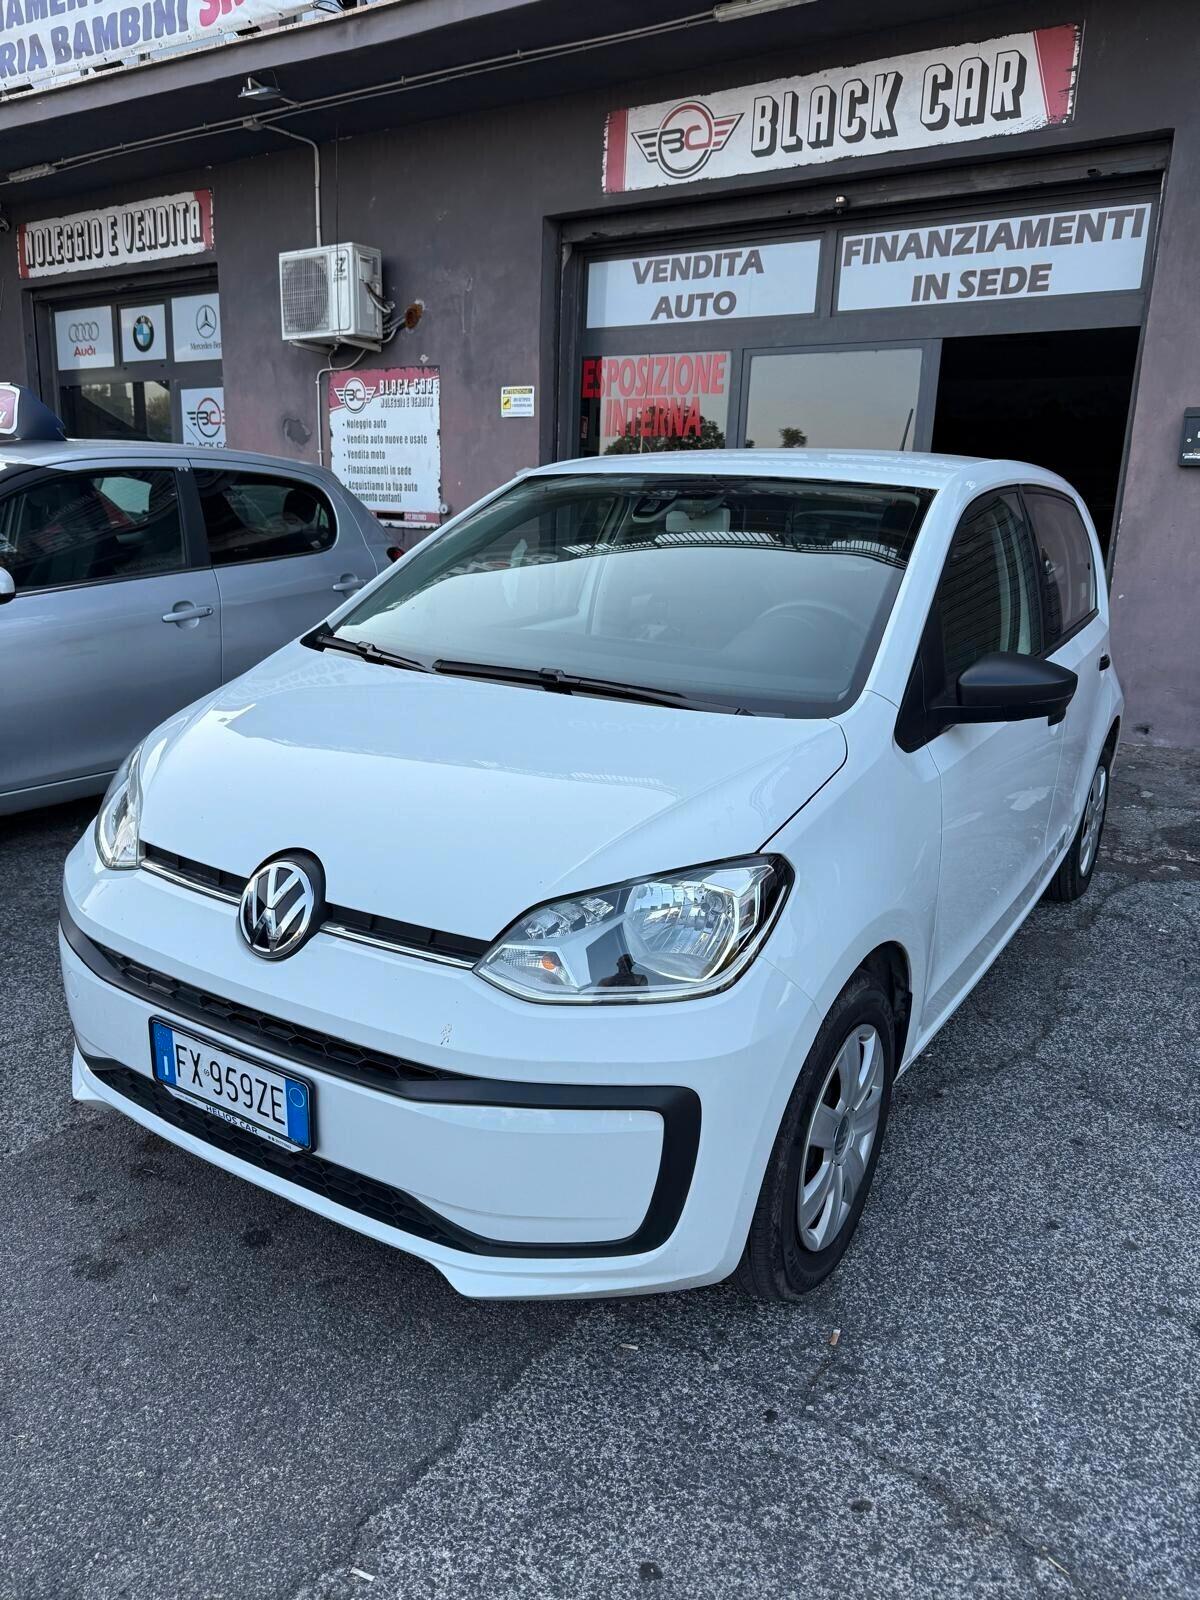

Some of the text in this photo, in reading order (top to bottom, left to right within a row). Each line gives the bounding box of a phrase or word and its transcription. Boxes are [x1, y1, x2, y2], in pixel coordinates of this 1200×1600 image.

[51, 0, 189, 65] BAMBINI
[751, 50, 1027, 158] BLACK CAR
[24, 200, 205, 269] NOLEGGIO E VENDITA
[842, 207, 1146, 268] FINANZIAMENTI
[632, 249, 765, 285] VENDITA
[911, 264, 1053, 302] IN SEDE
[650, 291, 737, 321] AUTO
[73, 345, 96, 357] Audi
[379, 378, 434, 395] BLACK CAR
[582, 353, 727, 398] ESPOSIZIONE
[346, 419, 387, 430] Noleggio auto
[604, 397, 703, 437] INTERNA
[347, 435, 370, 444] Vendita
[372, 435, 384, 444] auto
[385, 436, 403, 444] nuove
[409, 435, 428, 444] usate
[348, 449, 386, 460] Vendita moto
[348, 465, 412, 475] Finanziamenti in sede
[348, 480, 418, 492] Acquistiamo la tua auto
[378, 493, 402, 503] contanti
[205, 1104, 258, 1134] HELIOS CAR
